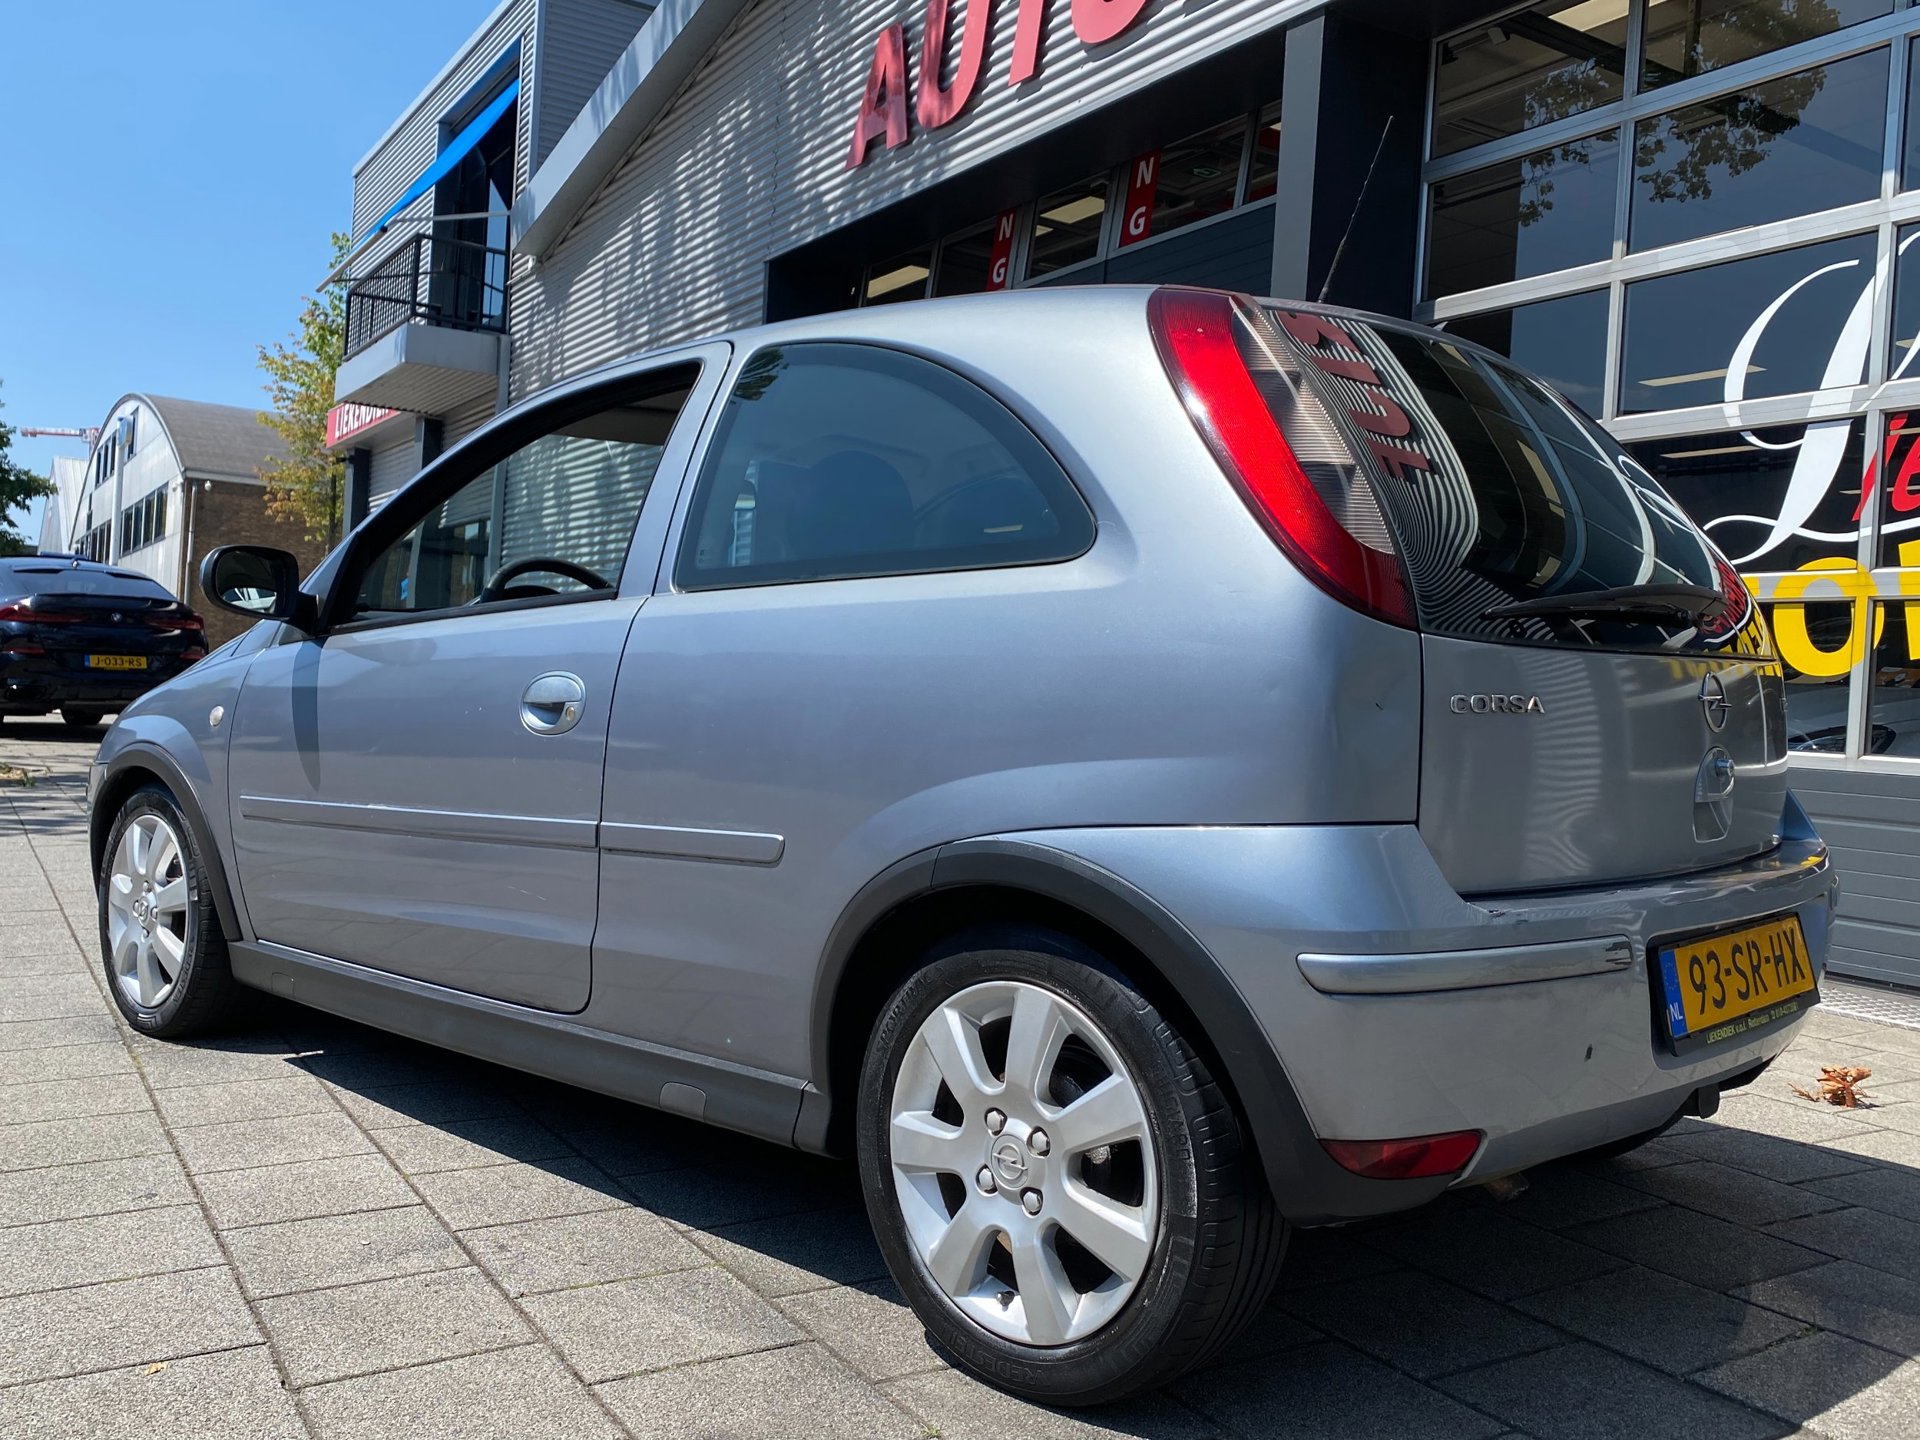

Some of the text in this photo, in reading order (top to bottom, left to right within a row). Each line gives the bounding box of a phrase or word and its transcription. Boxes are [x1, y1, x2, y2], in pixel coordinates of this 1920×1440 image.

[845, 0, 1147, 170] AU
[1450, 694, 1545, 714] CORSA
[1689, 926, 1806, 1016] 93-SR-HX
[1669, 1001, 1683, 1022] NL
